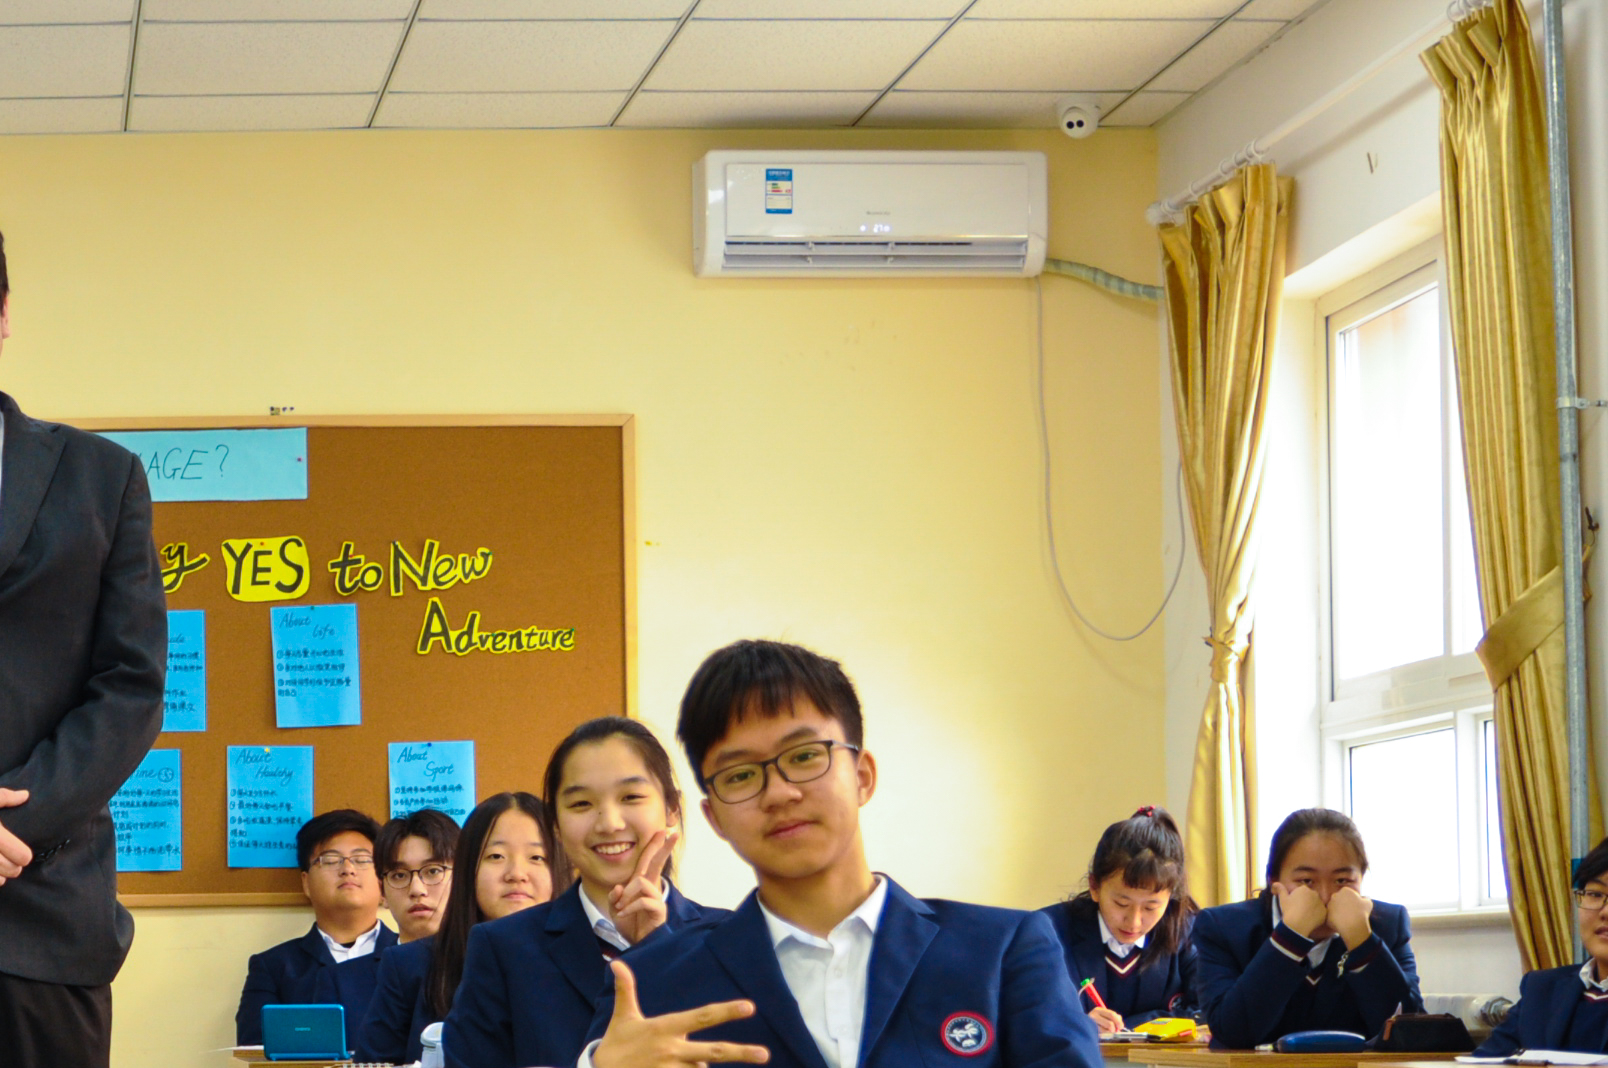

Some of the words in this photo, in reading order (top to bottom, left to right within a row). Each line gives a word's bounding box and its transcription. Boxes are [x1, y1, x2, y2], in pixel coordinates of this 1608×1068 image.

[223, 538, 304, 595] YES
[331, 544, 381, 593] to
[392, 541, 491, 594] New
[279, 612, 311, 628] About
[419, 599, 574, 653] Adventure
[397, 746, 428, 763] About
[132, 768, 158, 778] ime
[423, 760, 454, 782] Sport
